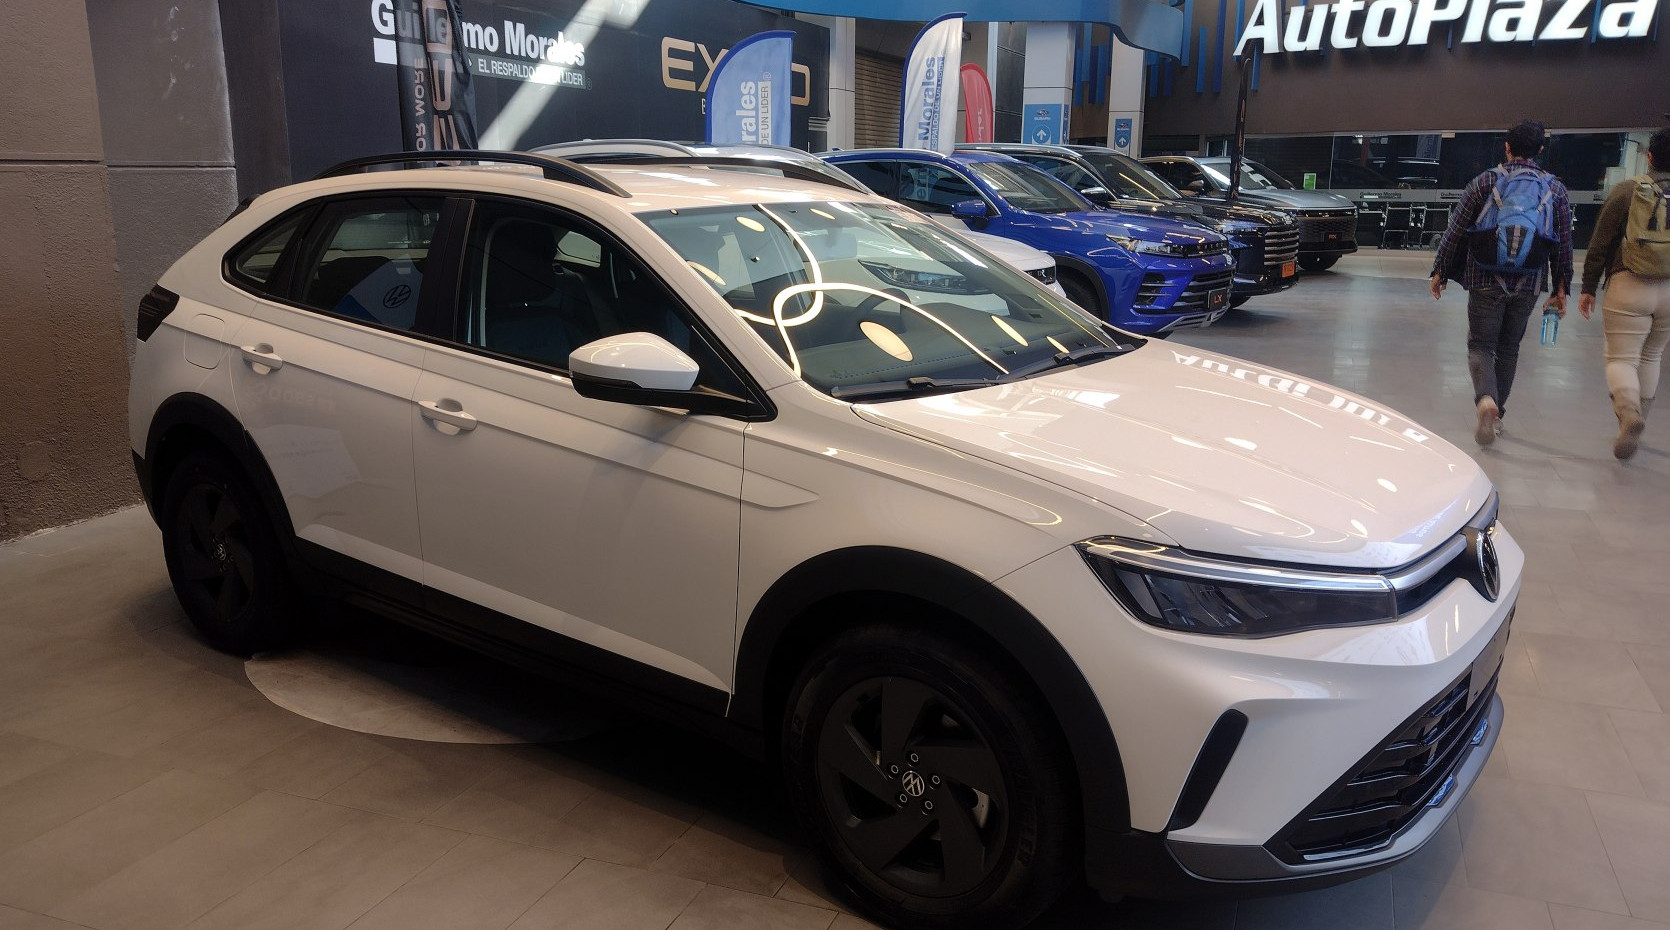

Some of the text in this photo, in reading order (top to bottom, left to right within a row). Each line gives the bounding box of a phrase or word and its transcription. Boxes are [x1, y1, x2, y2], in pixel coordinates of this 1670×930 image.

[504, 20, 585, 66] Morales
[1233, 0, 1658, 56] AutoPlaza
[478, 58, 490, 74] EL
[661, 36, 811, 106] EXD
[736, 81, 756, 142] rales
[761, 86, 769, 113] LIDER
[761, 116, 769, 129] UN
[918, 57, 936, 140] Morales
